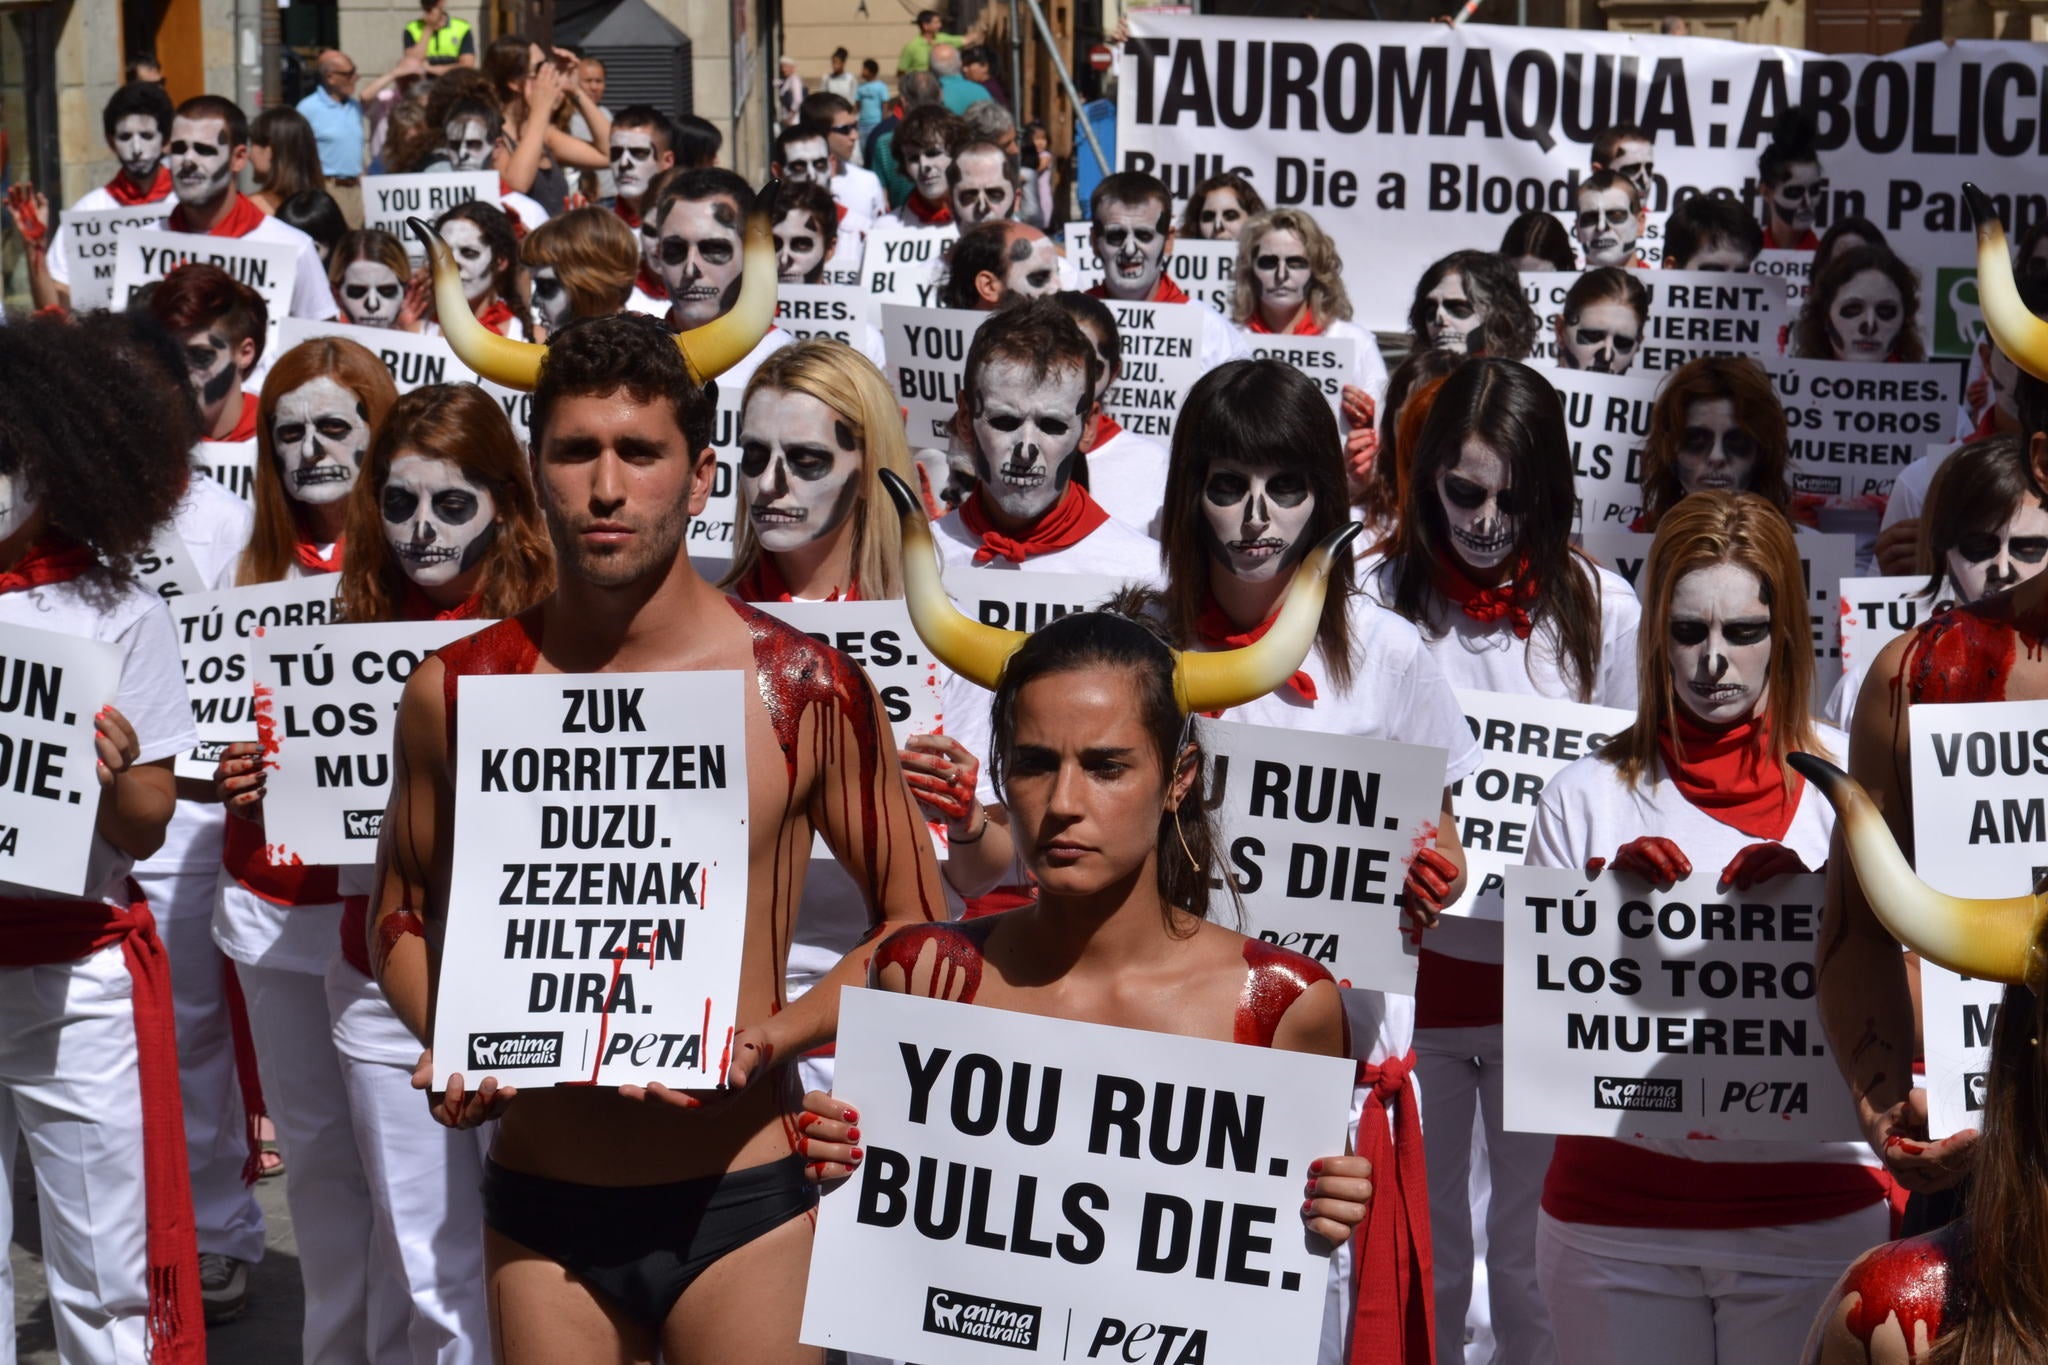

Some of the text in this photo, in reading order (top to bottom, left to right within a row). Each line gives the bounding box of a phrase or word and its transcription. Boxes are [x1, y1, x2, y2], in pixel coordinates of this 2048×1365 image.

[378, 187, 420, 212] YOU
[1276, 157, 1358, 207] Die
[1377, 172, 1406, 210] a
[1429, 163, 1581, 215] Blood
[1887, 179, 2048, 246] Pamp
[72, 217, 101, 236] TÚ
[884, 239, 931, 264] YOU
[1163, 254, 1208, 280] YOU
[1754, 260, 1812, 276] CORR
[777, 300, 856, 321] RRES.
[1667, 285, 1769, 312] RENT.
[1117, 308, 1156, 329] ZUK
[1647, 315, 1760, 344] IEREN
[903, 324, 963, 362] YOU
[1120, 335, 1192, 359] RITZEN
[1252, 348, 1343, 369] ORRES.
[380, 349, 454, 385] RUN
[1119, 361, 1164, 384] UZU.
[1810, 376, 1948, 402] CORRES.
[502, 395, 533, 427] YO
[1605, 396, 1653, 437] RU
[1785, 406, 1941, 434] OS TOROS
[691, 520, 734, 542] PeT
[180, 600, 340, 643] TÚ CORR
[1858, 593, 1917, 631] TÚ
[183, 653, 246, 685] LOS
[270, 643, 438, 686] TÚ CO
[0, 655, 76, 726] UN.
[192, 696, 258, 724] MU
[284, 702, 378, 738] LOS
[562, 688, 647, 733] ZUK
[315, 753, 389, 788] MU
[481, 744, 727, 793] KORRITZEN
[1249, 759, 1399, 830] RUN.
[541, 804, 671, 849] DUZU.
[1968, 798, 2047, 845] AM
[499, 862, 700, 905] ZEZENAK
[1286, 842, 1408, 908] DIE.
[1525, 889, 1825, 942] TÚ CORRE
[504, 919, 686, 960] HILTZEN
[528, 972, 653, 1014] DIRA.
[1537, 954, 1817, 1001] LOS TORO
[499, 1034, 558, 1053] anima
[1567, 1012, 1825, 1057] MUEREN.
[498, 1050, 557, 1066] naturalis
[1623, 1081, 1678, 1098] anima
[1623, 1096, 1678, 1110] naturalis
[899, 1042, 1289, 1177] YOU RUN.
[857, 1145, 1302, 1292] BULLS DIE.
[963, 1303, 1034, 1330] anima
[961, 1322, 1032, 1345] naturalis
